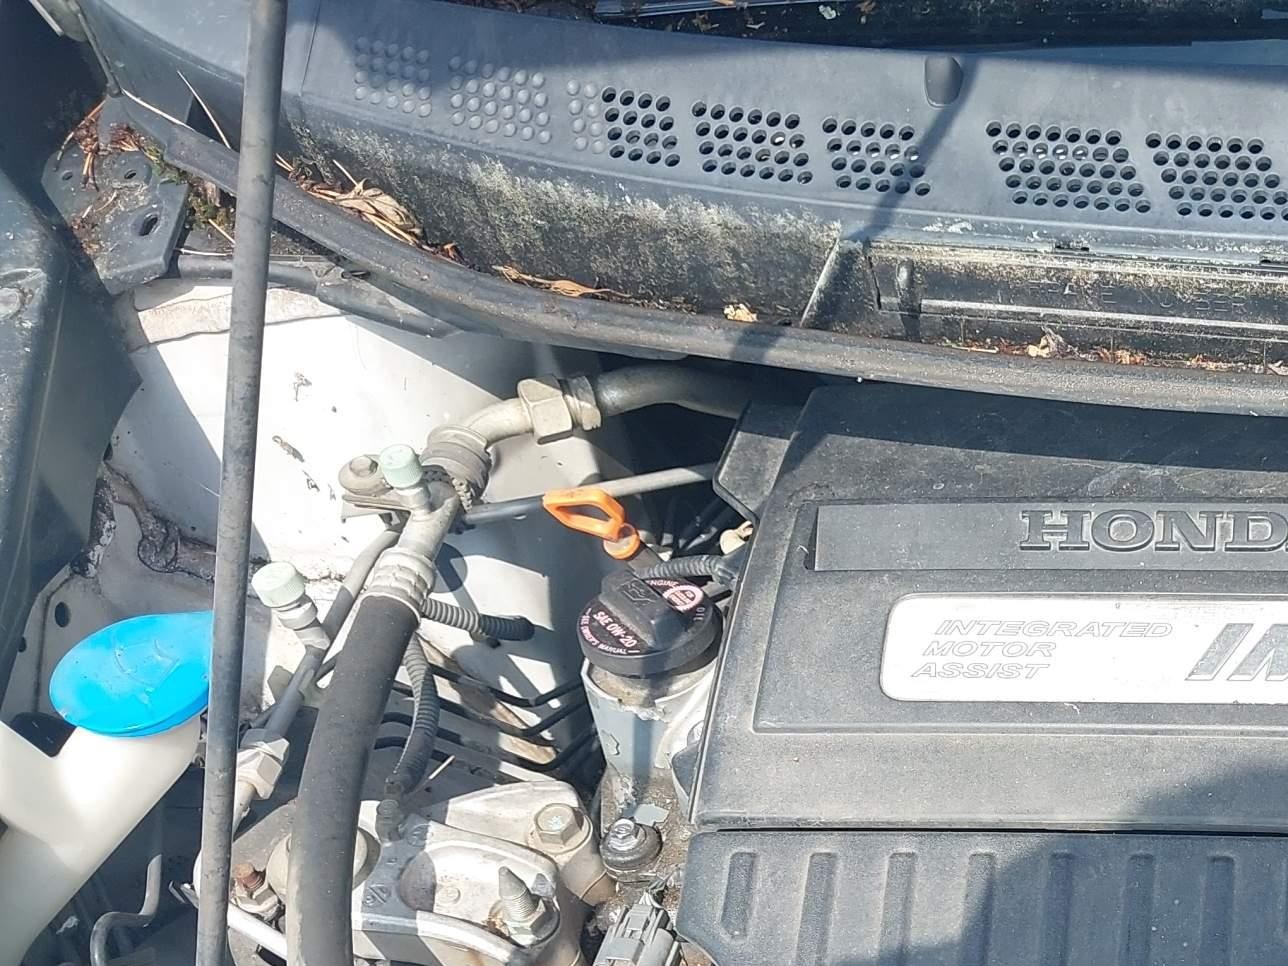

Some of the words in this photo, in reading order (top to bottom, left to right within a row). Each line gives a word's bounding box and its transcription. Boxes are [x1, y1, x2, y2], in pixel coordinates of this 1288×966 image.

[592, 611, 614, 626] SAE
[934, 619, 1173, 638] INTEGRATED
[922, 640, 1057, 658] MOTOR
[911, 662, 1050, 679] ASSIST
